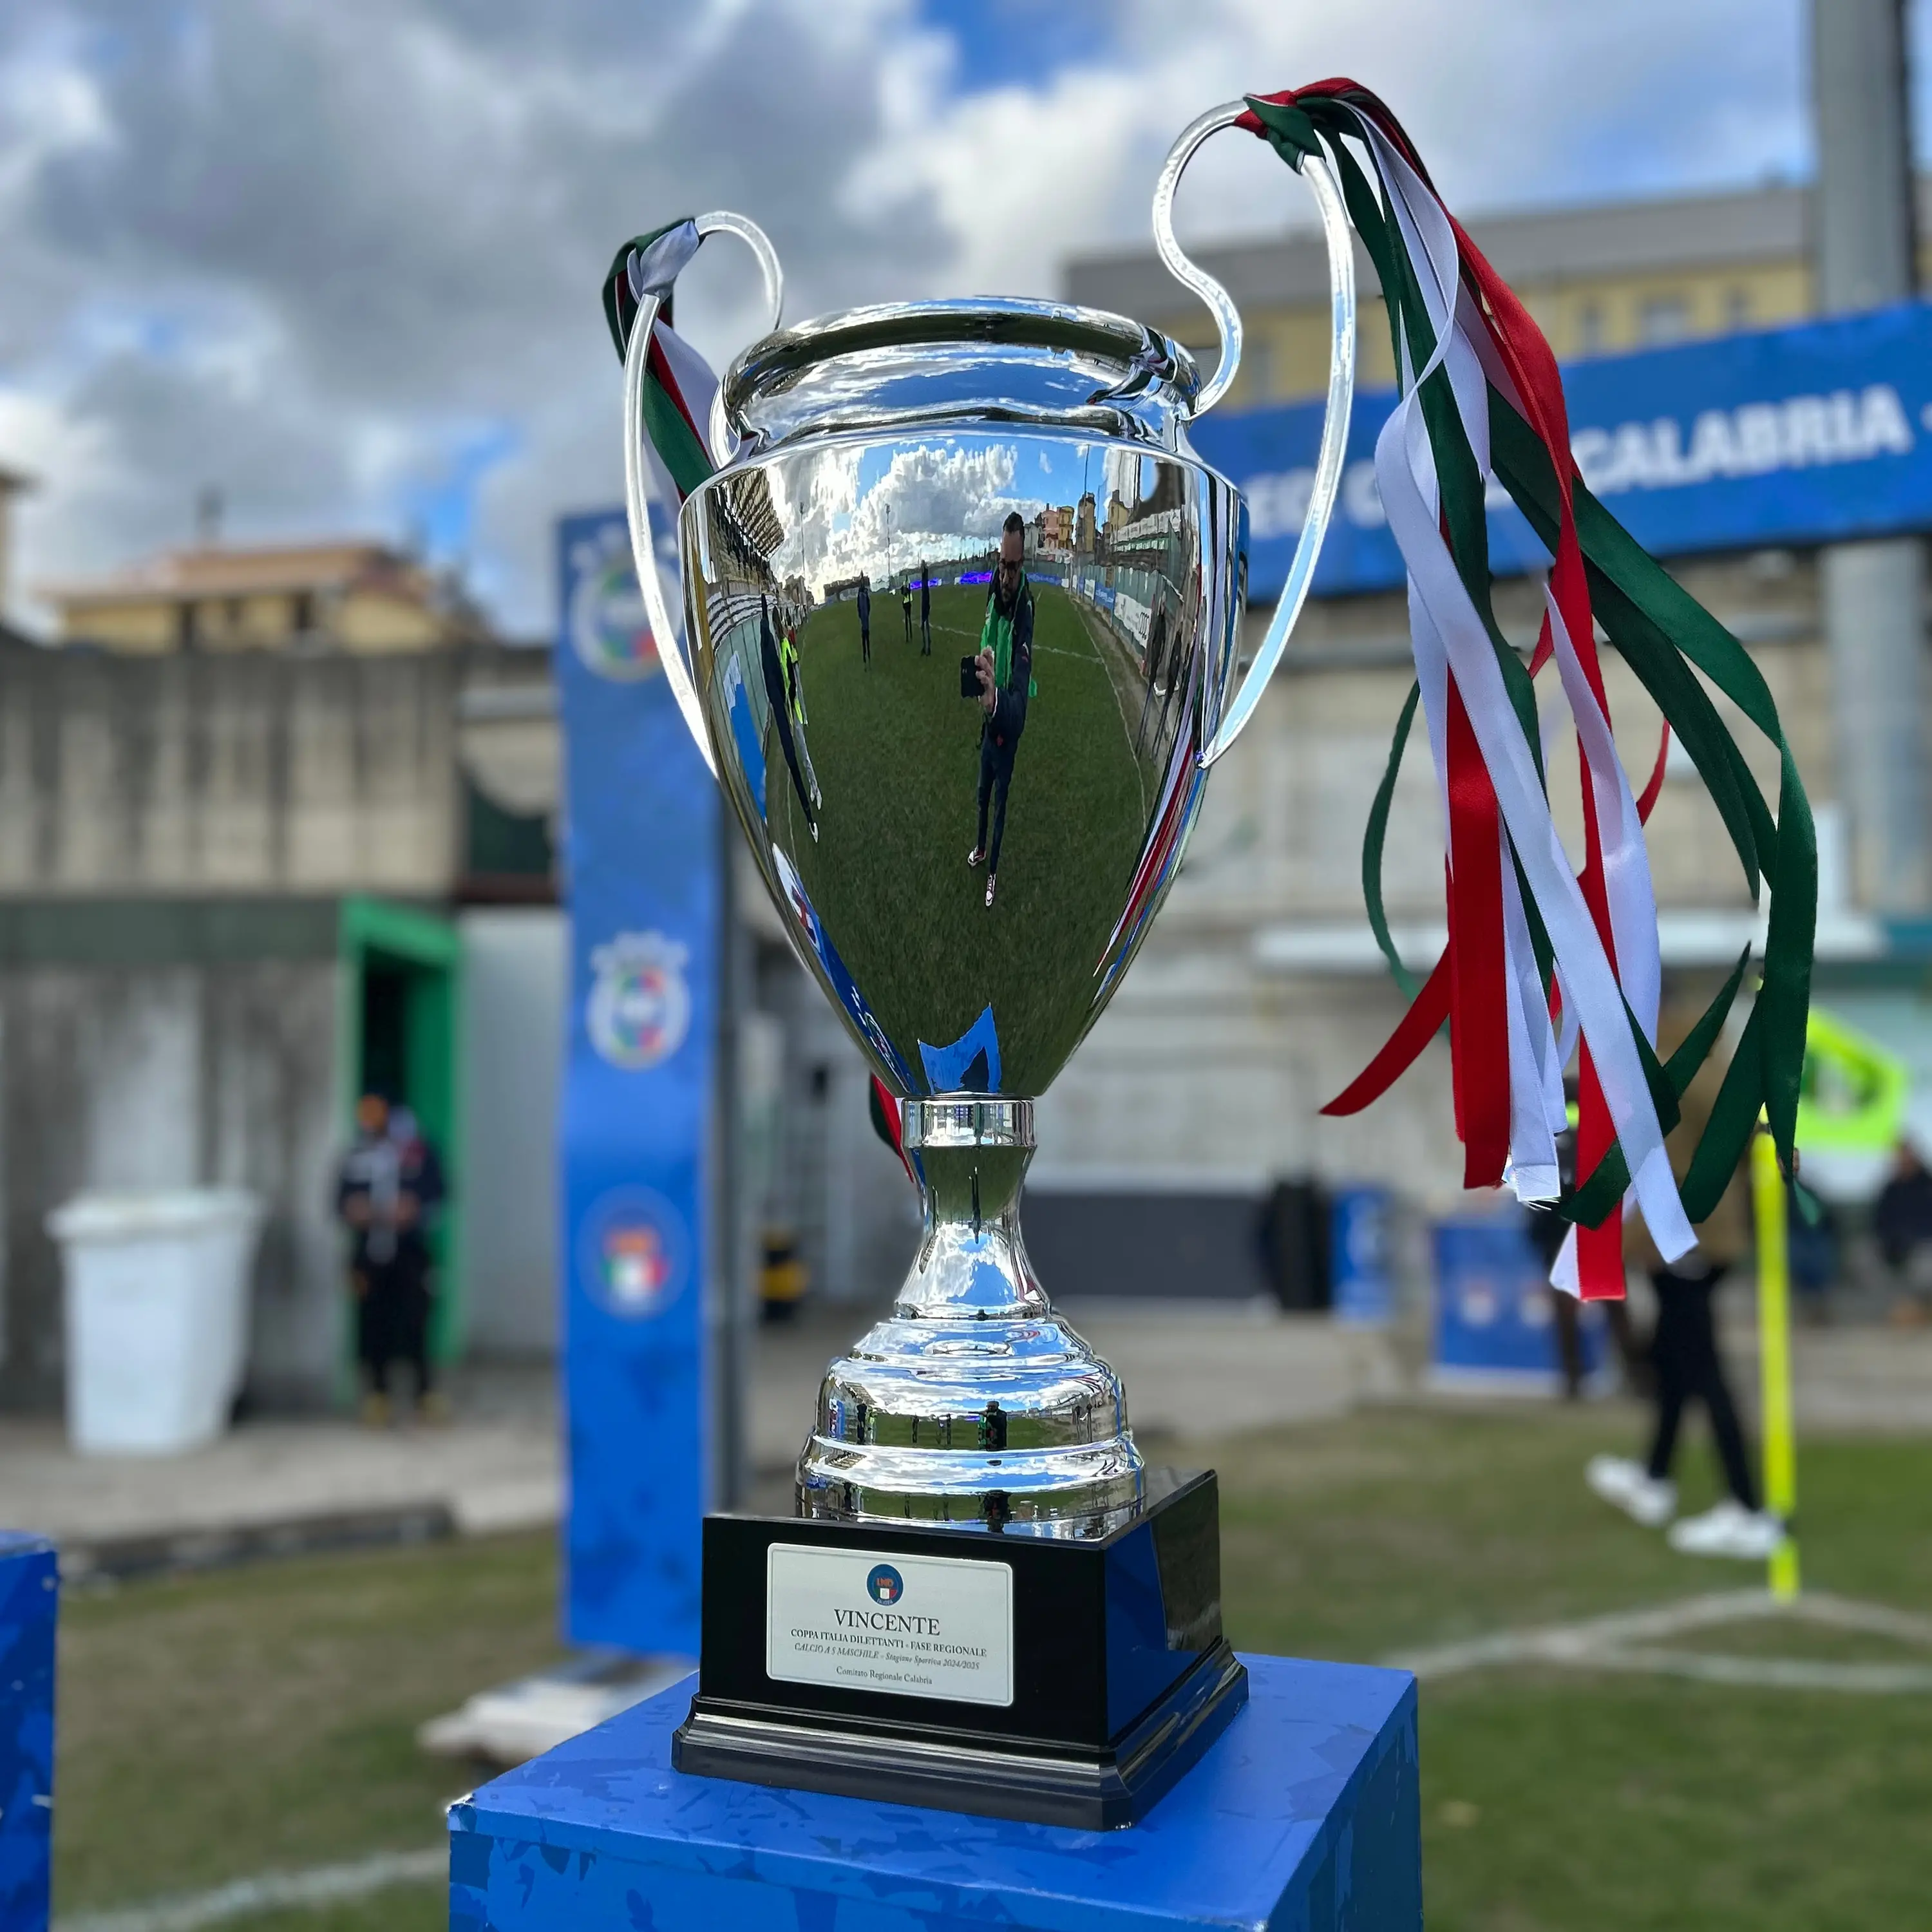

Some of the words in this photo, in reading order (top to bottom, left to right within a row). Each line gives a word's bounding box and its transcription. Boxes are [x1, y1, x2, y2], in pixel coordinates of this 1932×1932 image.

[1570, 385, 1911, 495] CALABRIA
[834, 1609, 940, 1636] VINCENTE
[791, 1629, 818, 1639] COPPA
[820, 1632, 848, 1642] ITALIA
[850, 1634, 904, 1649] DILETTANTI
[911, 1641, 931, 1651] FASE
[933, 1643, 987, 1657] REGIONALE
[795, 1642, 823, 1653] CALCIO
[837, 1647, 879, 1659] MASCHILE
[886, 1652, 912, 1663] Stagione
[914, 1655, 941, 1666] Sportiva
[943, 1659, 980, 1670] 2024/2025
[837, 1666, 867, 1677] Comitato
[869, 1669, 902, 1681] Regionale
[904, 1673, 932, 1685] Calabria
